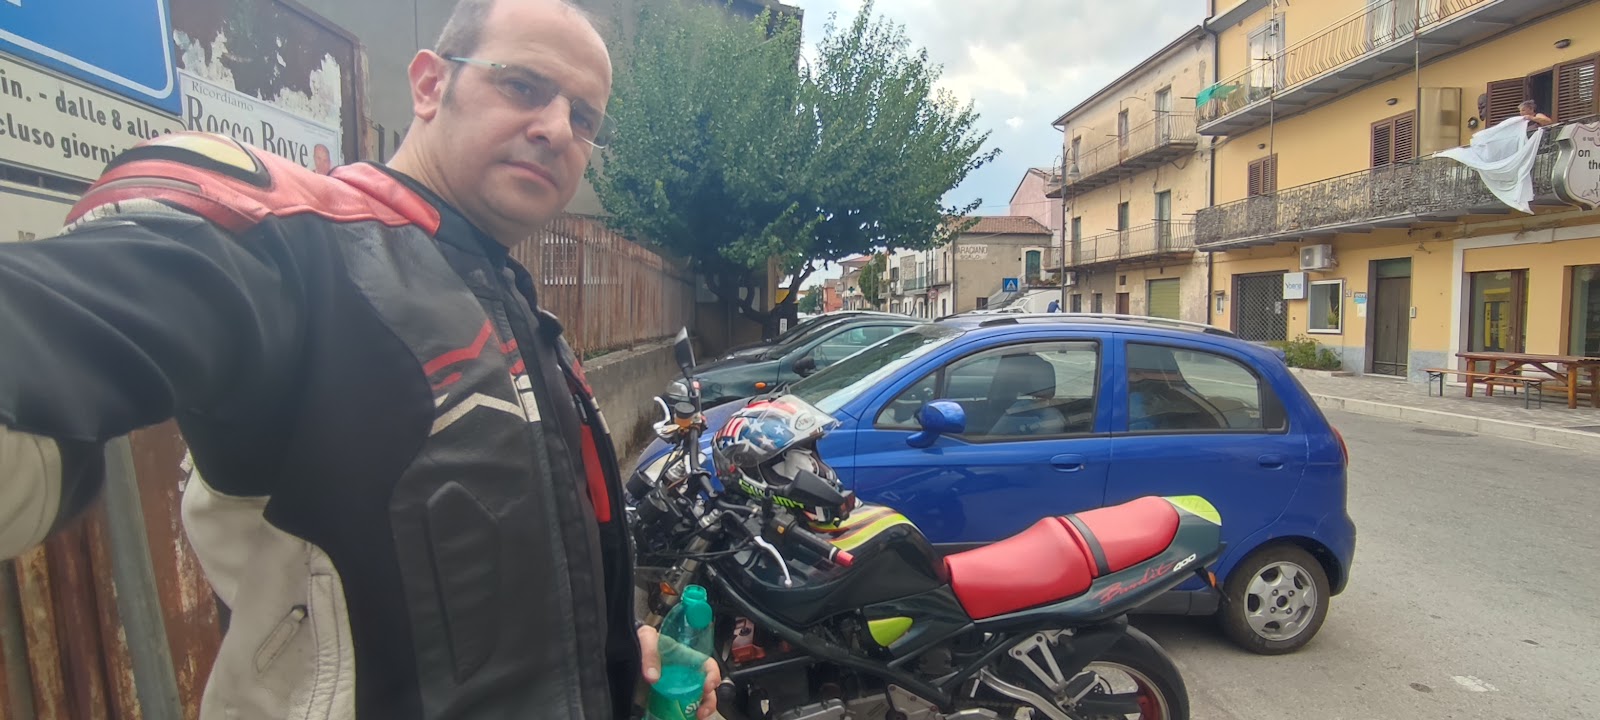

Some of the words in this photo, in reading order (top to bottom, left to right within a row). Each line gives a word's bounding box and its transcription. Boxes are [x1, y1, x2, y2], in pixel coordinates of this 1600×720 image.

[56, 90, 107, 126] dalle
[111, 109, 122, 131] 8
[127, 117, 159, 140] alle
[192, 80, 254, 112] Ricordiamo
[61, 133, 115, 164] giorni
[186, 94, 254, 145] Rocco
[261, 120, 308, 168] Bove
[1578, 149, 1590, 158] on
[1091, 559, 1178, 605] Bandit
[1173, 553, 1197, 572] 400
